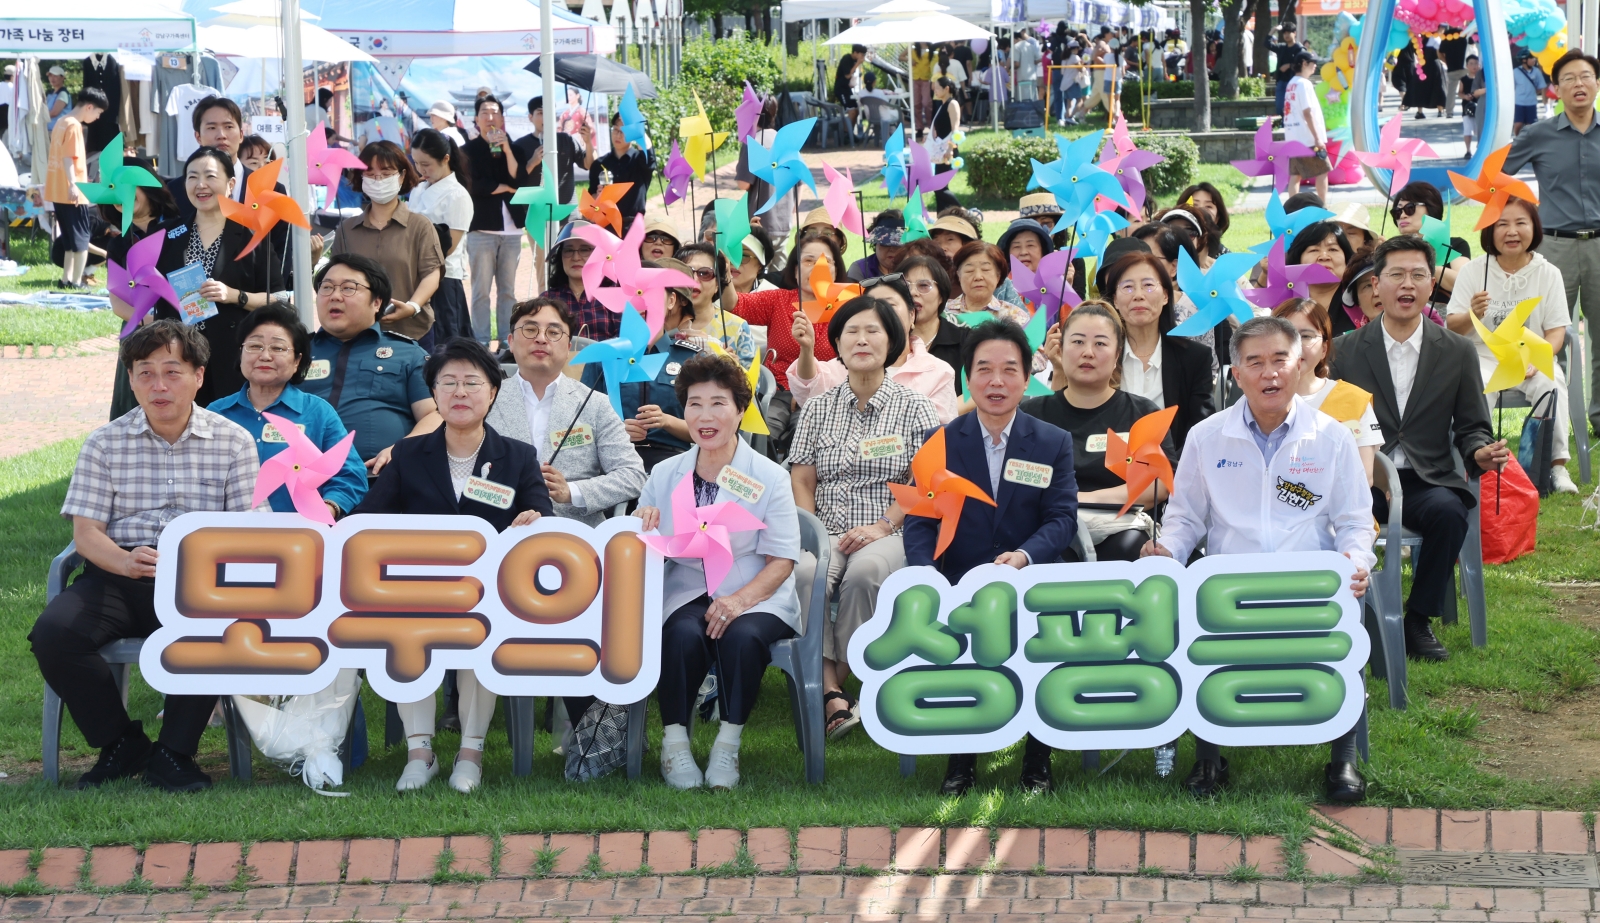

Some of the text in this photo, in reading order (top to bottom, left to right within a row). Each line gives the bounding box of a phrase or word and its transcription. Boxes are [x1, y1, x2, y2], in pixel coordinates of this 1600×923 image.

[1, 29, 85, 42] 가족 나눔 장터
[256, 124, 283, 133] 여름 옷
[870, 444, 896, 458] 정은희
[1227, 460, 1243, 468] 강남구
[1278, 488, 1311, 511] 김현기
[161, 527, 647, 685] 모두의
[863, 570, 1353, 736] 성평등
